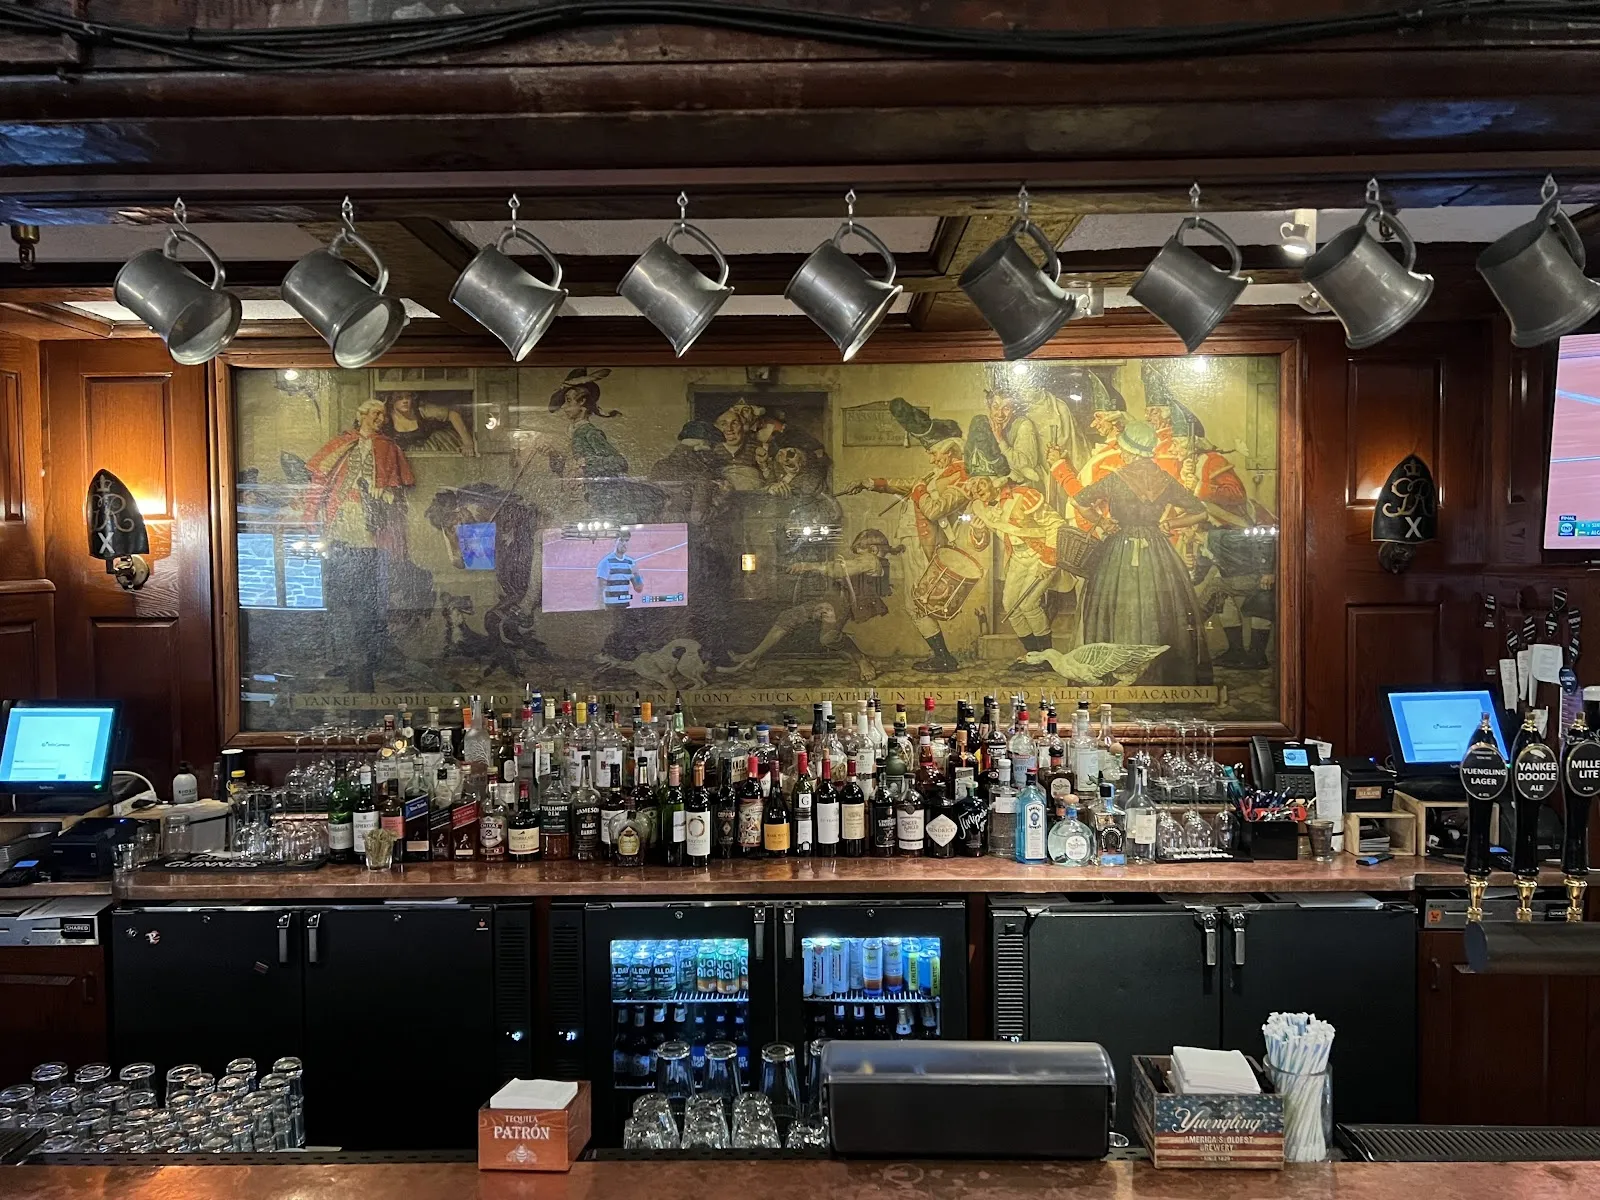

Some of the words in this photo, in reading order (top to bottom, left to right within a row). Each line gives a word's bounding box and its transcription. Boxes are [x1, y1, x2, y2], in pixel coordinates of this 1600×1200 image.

[303, 697, 359, 706] YANKEE
[370, 697, 430, 706] DOODLE
[694, 692, 732, 702] PONY
[750, 692, 794, 702] STUCK
[802, 692, 810, 701] A
[822, 691, 879, 701] FEATHER
[891, 691, 905, 700] IN
[953, 691, 979, 700] HAT
[1105, 690, 1118, 699] IT
[1129, 689, 1209, 699] MACARONI
[1519, 762, 1557, 771] YANKEE
[1571, 760, 1600, 768] MILLE
[1517, 772, 1557, 781] DOODLE
[1579, 770, 1599, 778] LITE
[576, 807, 600, 815] JAMESON
[164, 860, 258, 868] GUINNESS
[505, 1115, 538, 1123] TEQUILA
[1172, 1107, 1266, 1134] Yuengling
[493, 1124, 550, 1140] PATRÓN
[1184, 1136, 1224, 1144] AMERICA'S
[1227, 1136, 1254, 1144] OLDEST
